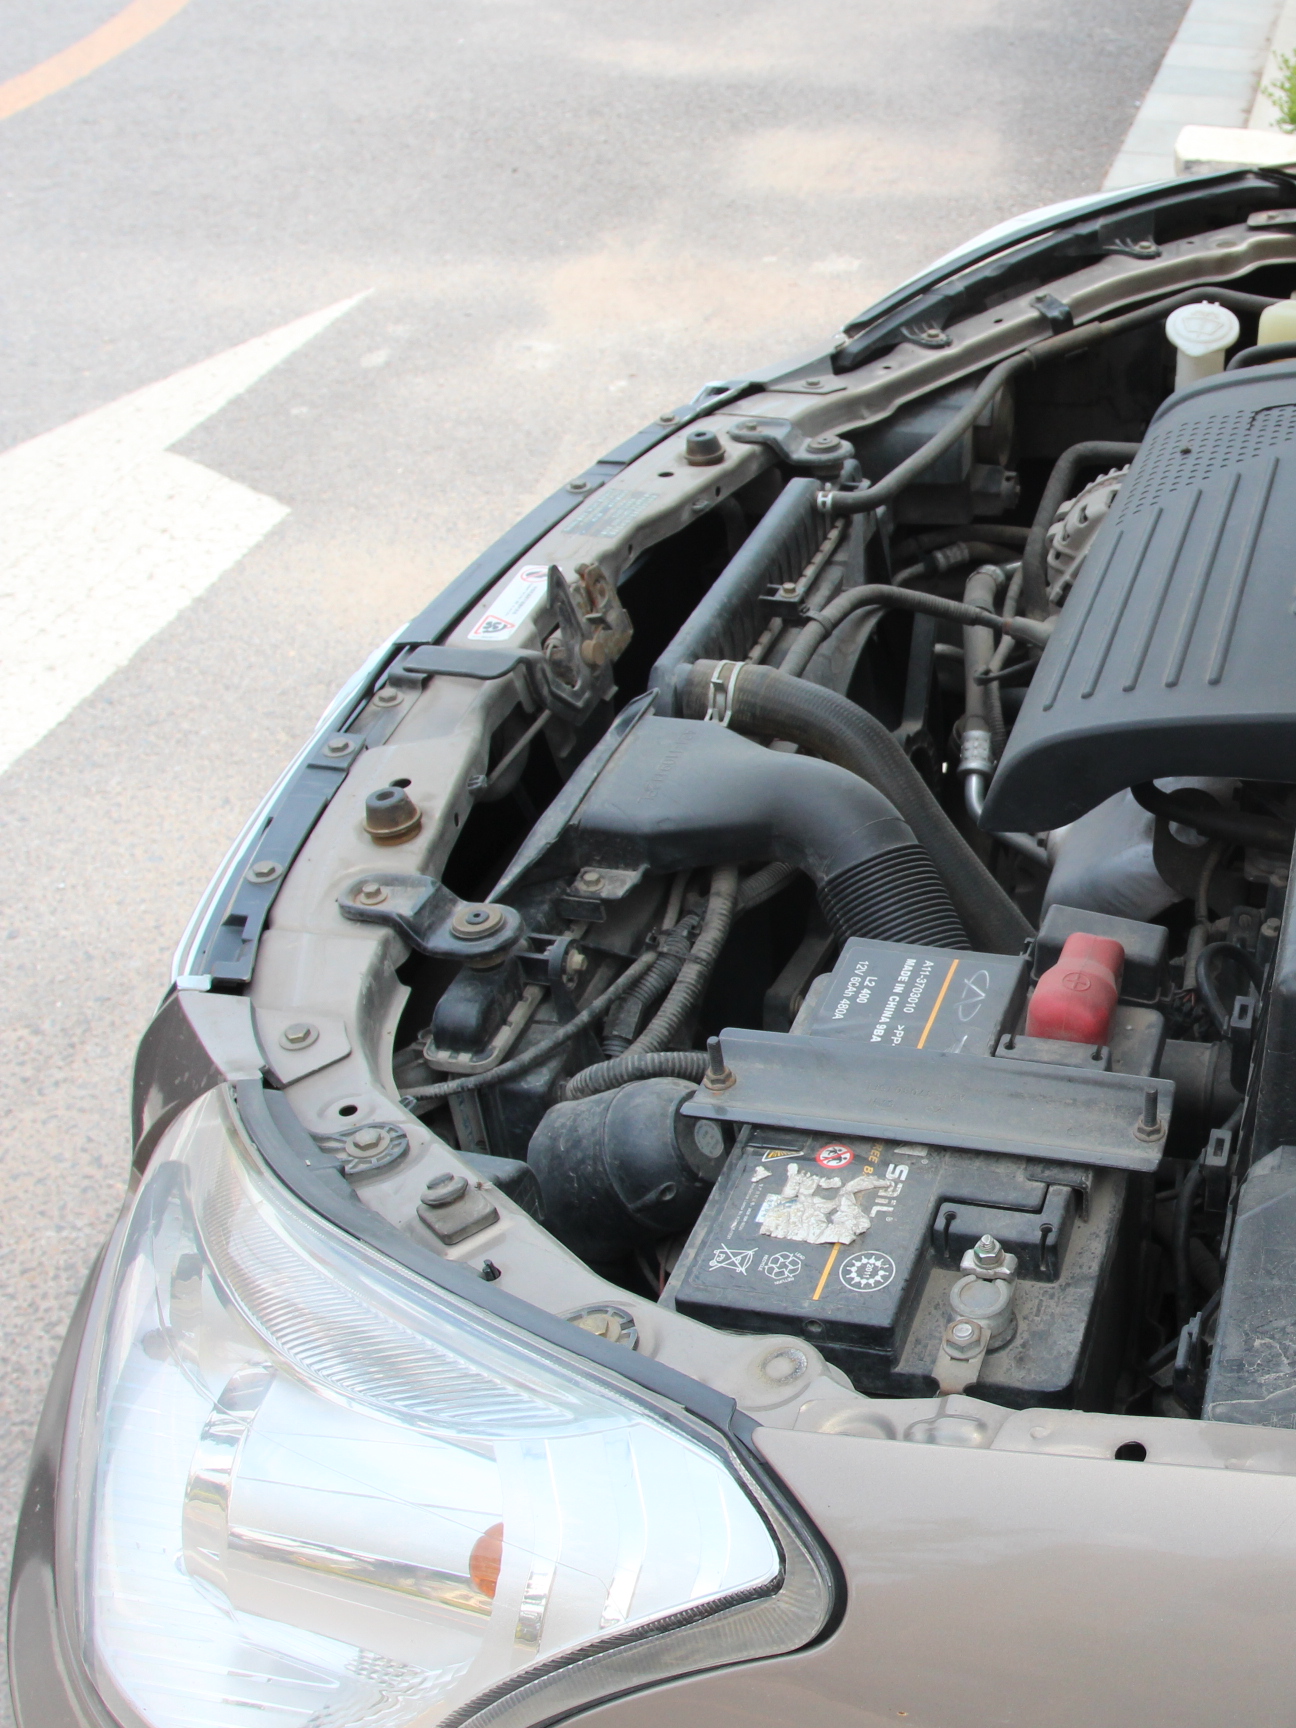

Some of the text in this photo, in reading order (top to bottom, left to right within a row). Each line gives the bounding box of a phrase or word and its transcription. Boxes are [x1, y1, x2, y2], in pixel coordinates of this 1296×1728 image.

[854, 961, 869, 975] 12V
[856, 976, 878, 1003] L2 400
[903, 960, 934, 1013] A11-3703010
[832, 998, 851, 1020] 480A
[870, 958, 917, 1042] MADE IN CHINA 9BA
[863, 1263, 874, 1278] 2011
